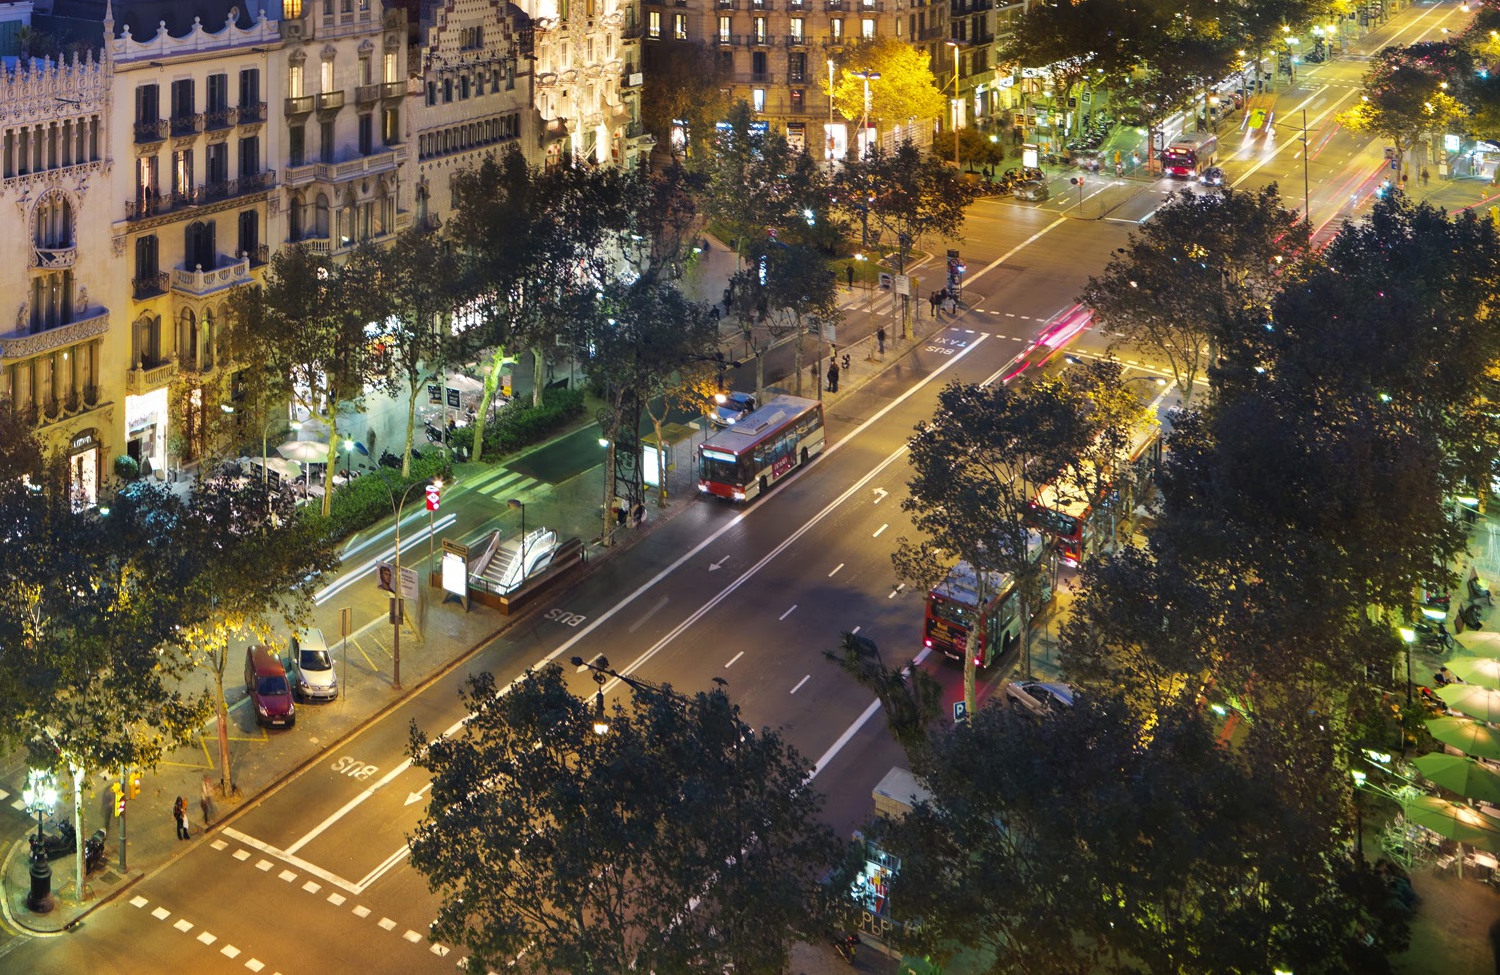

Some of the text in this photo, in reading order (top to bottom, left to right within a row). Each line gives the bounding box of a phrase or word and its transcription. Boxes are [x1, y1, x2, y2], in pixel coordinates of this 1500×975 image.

[934, 337, 967, 347] TAXI
[925, 345, 956, 355] BUS
[543, 607, 587, 627] BUS
[956, 704, 964, 716] P
[330, 755, 379, 782] BUS
